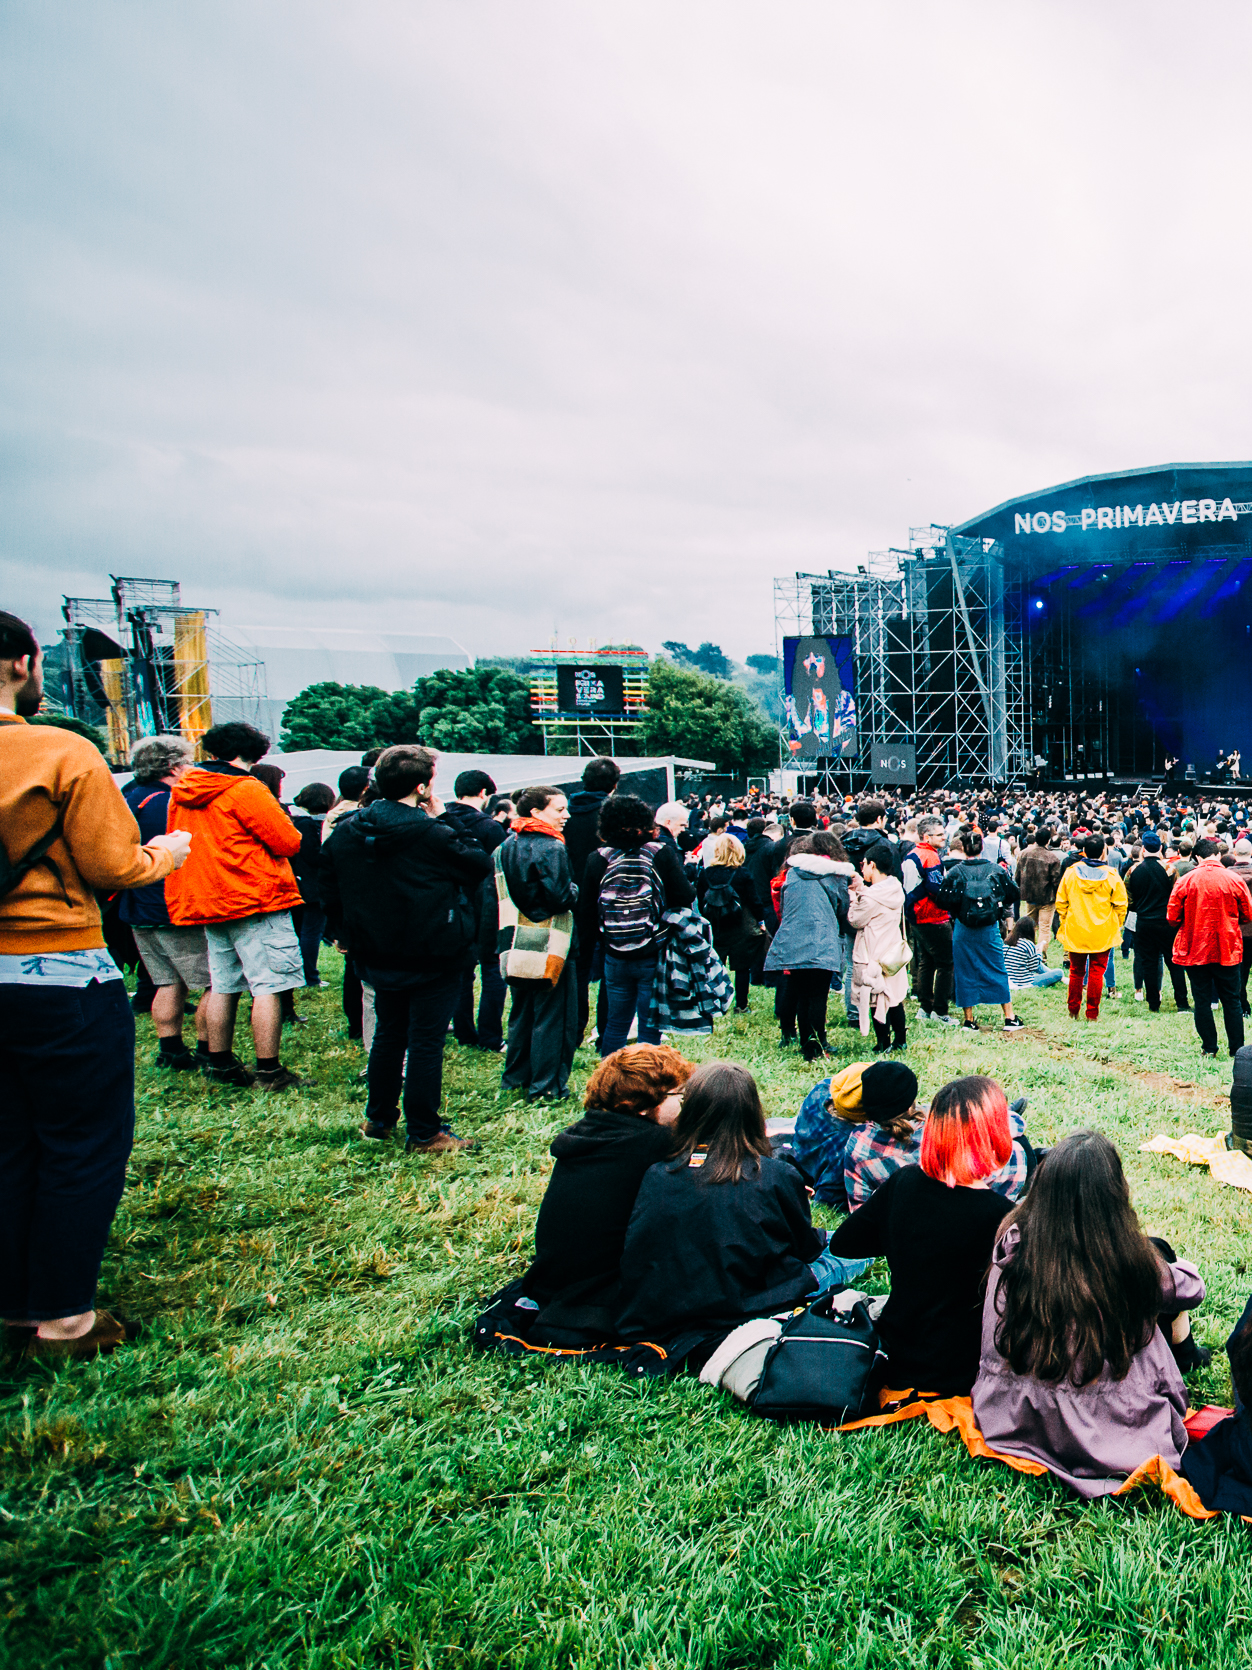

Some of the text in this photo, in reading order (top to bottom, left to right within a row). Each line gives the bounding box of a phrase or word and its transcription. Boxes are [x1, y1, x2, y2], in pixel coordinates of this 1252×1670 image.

[1014, 511, 1067, 534] NOS
[1081, 497, 1238, 531] PRIMAVERA
[880, 756, 907, 772] NOS
